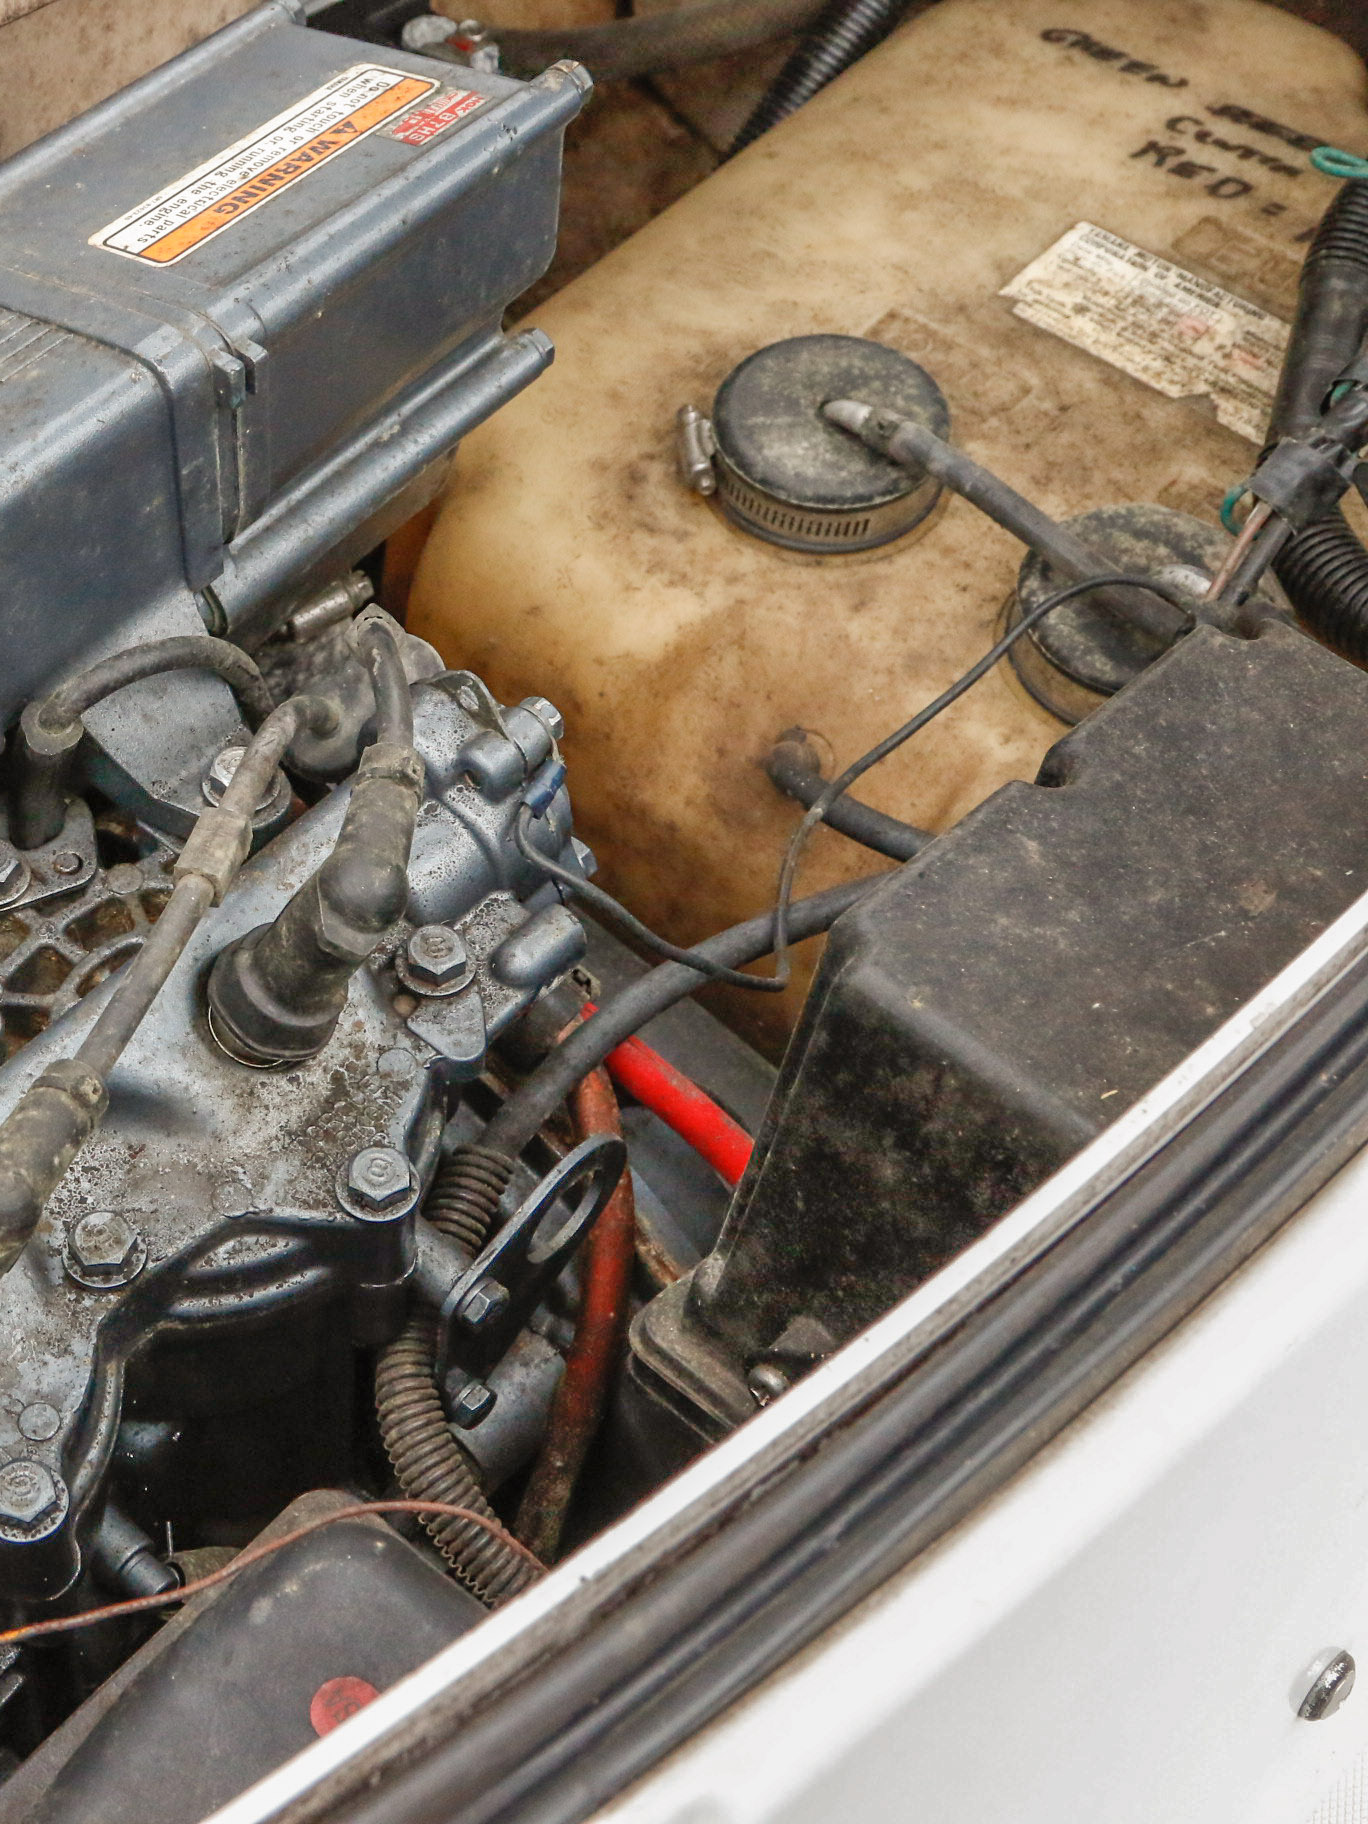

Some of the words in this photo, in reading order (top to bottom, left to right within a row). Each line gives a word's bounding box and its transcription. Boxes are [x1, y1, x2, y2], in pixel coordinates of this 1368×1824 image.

[339, 77, 373, 98] when
[368, 81, 391, 93] Do
[344, 93, 369, 108] not
[283, 101, 336, 134] starting
[306, 111, 344, 134] touch
[290, 135, 305, 146] or
[215, 147, 265, 179] running
[239, 146, 287, 178] remove
[191, 181, 216, 195] the
[214, 139, 339, 215] WARNING
[177, 179, 238, 219] electrical
[137, 219, 175, 244] parts
